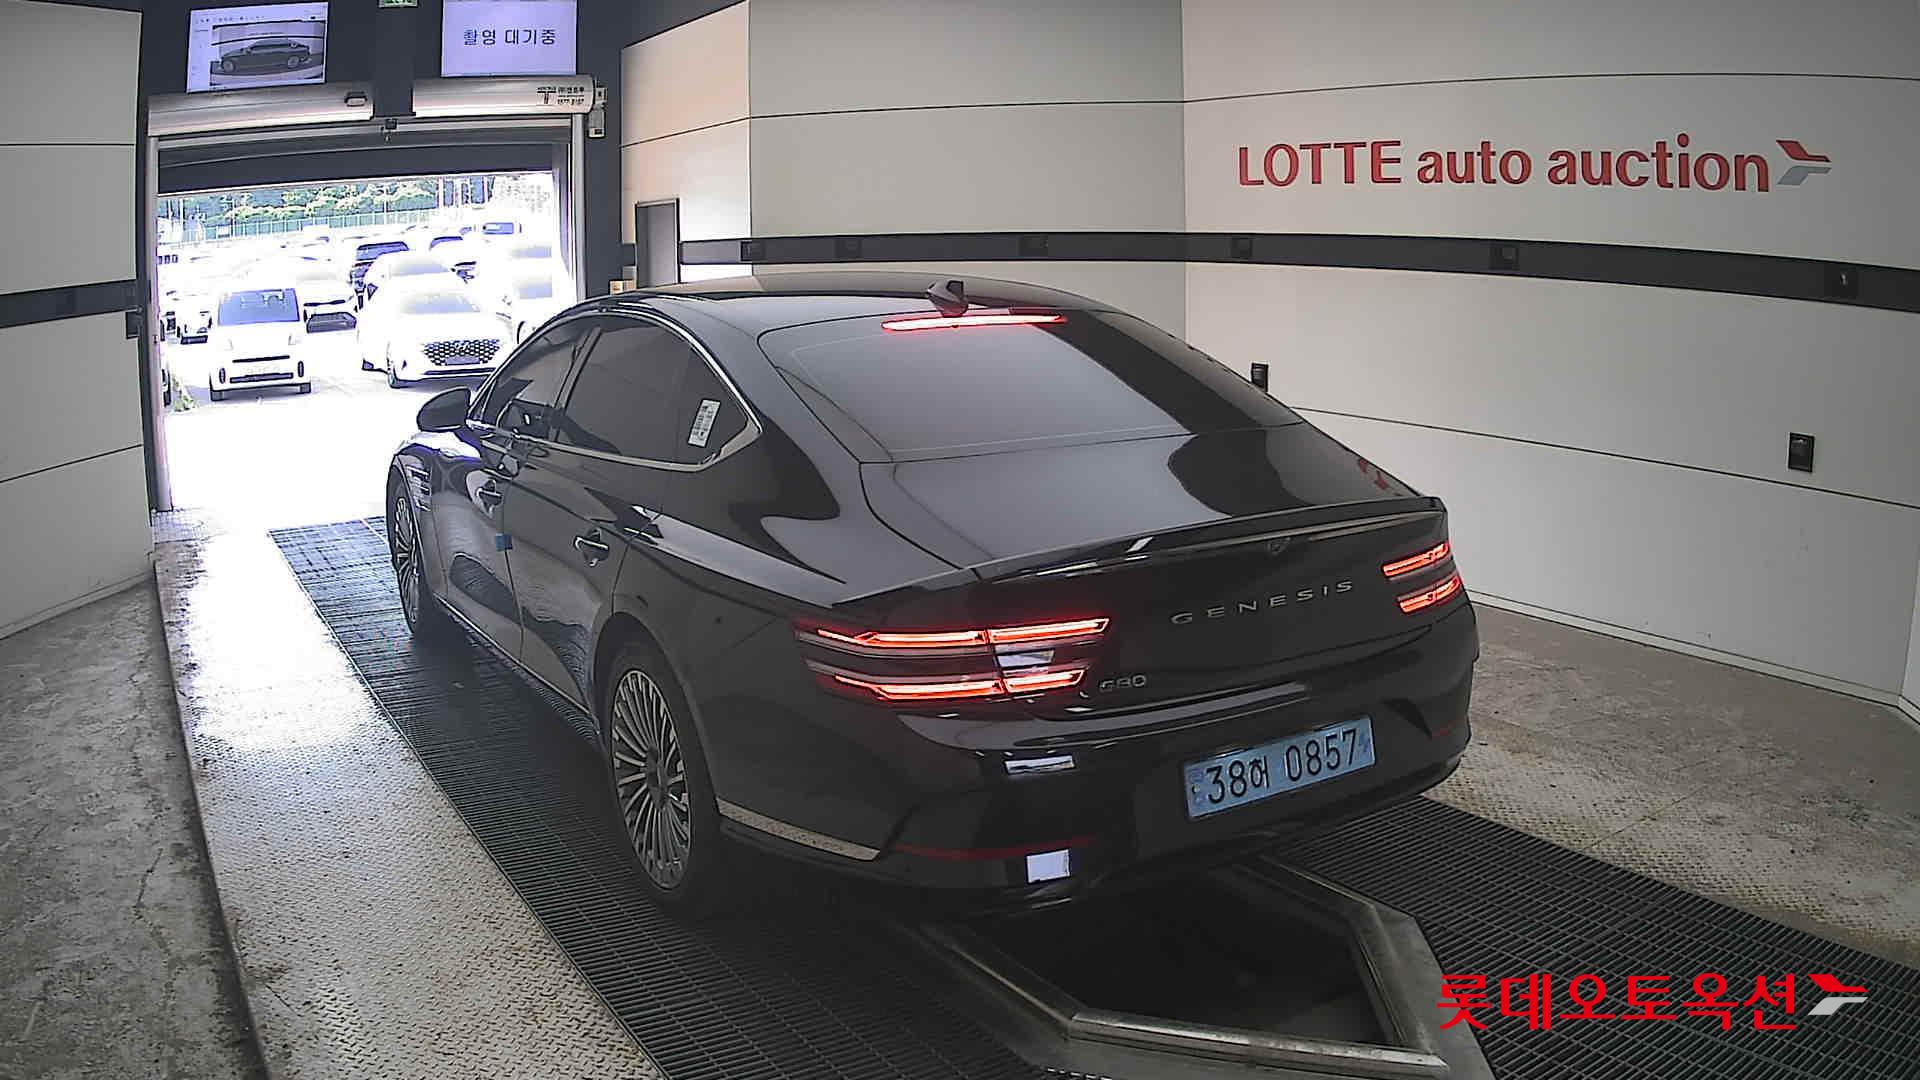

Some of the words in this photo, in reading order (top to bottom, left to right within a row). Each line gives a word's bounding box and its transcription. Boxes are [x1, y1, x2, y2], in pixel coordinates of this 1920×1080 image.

[504, 28, 556, 46] 대기중
[1239, 140, 1402, 187] LOTTE
[1416, 141, 1532, 185] auto
[1547, 133, 1769, 193] auction
[1170, 579, 1353, 625] GENESIS
[1206, 756, 1270, 804] 38허
[1285, 729, 1357, 782] 0857
